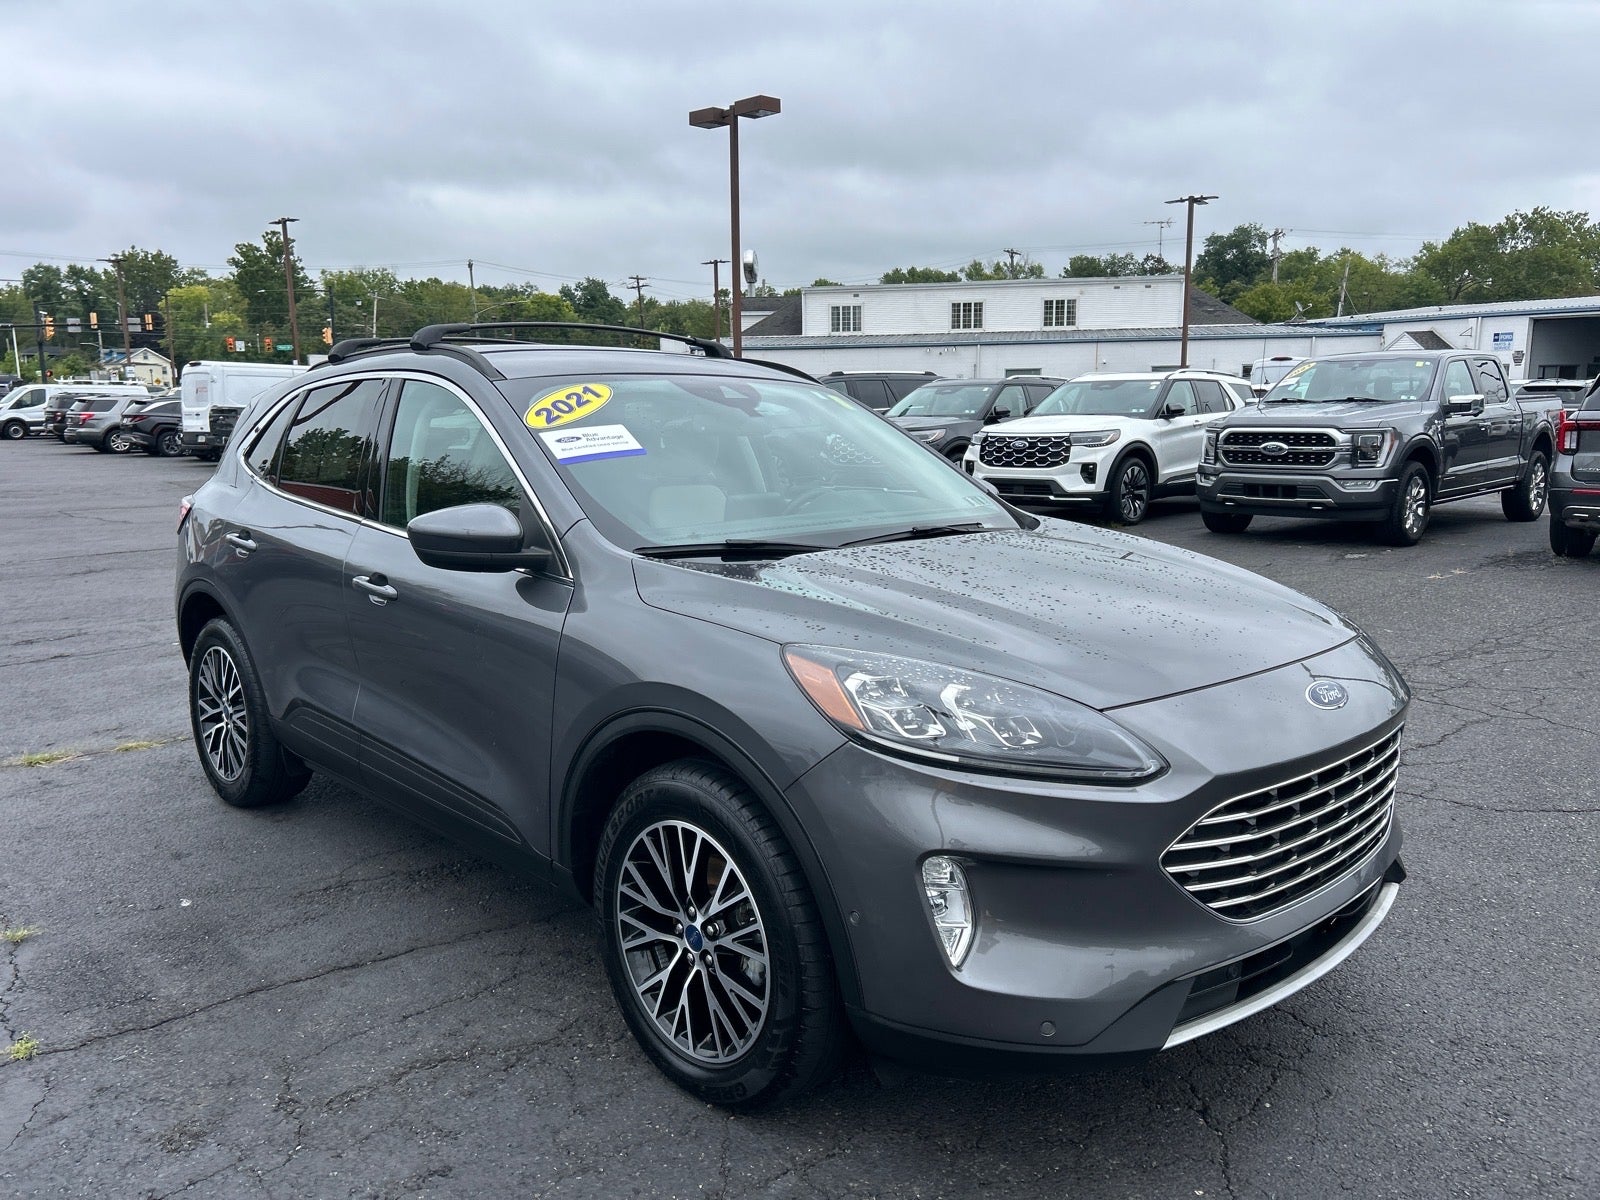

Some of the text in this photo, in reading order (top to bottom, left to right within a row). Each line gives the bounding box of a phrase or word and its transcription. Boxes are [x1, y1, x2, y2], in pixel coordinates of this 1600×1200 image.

[534, 385, 604, 425] 2021
[586, 434, 624, 442] Advantage
[1316, 685, 1342, 703] Ford
